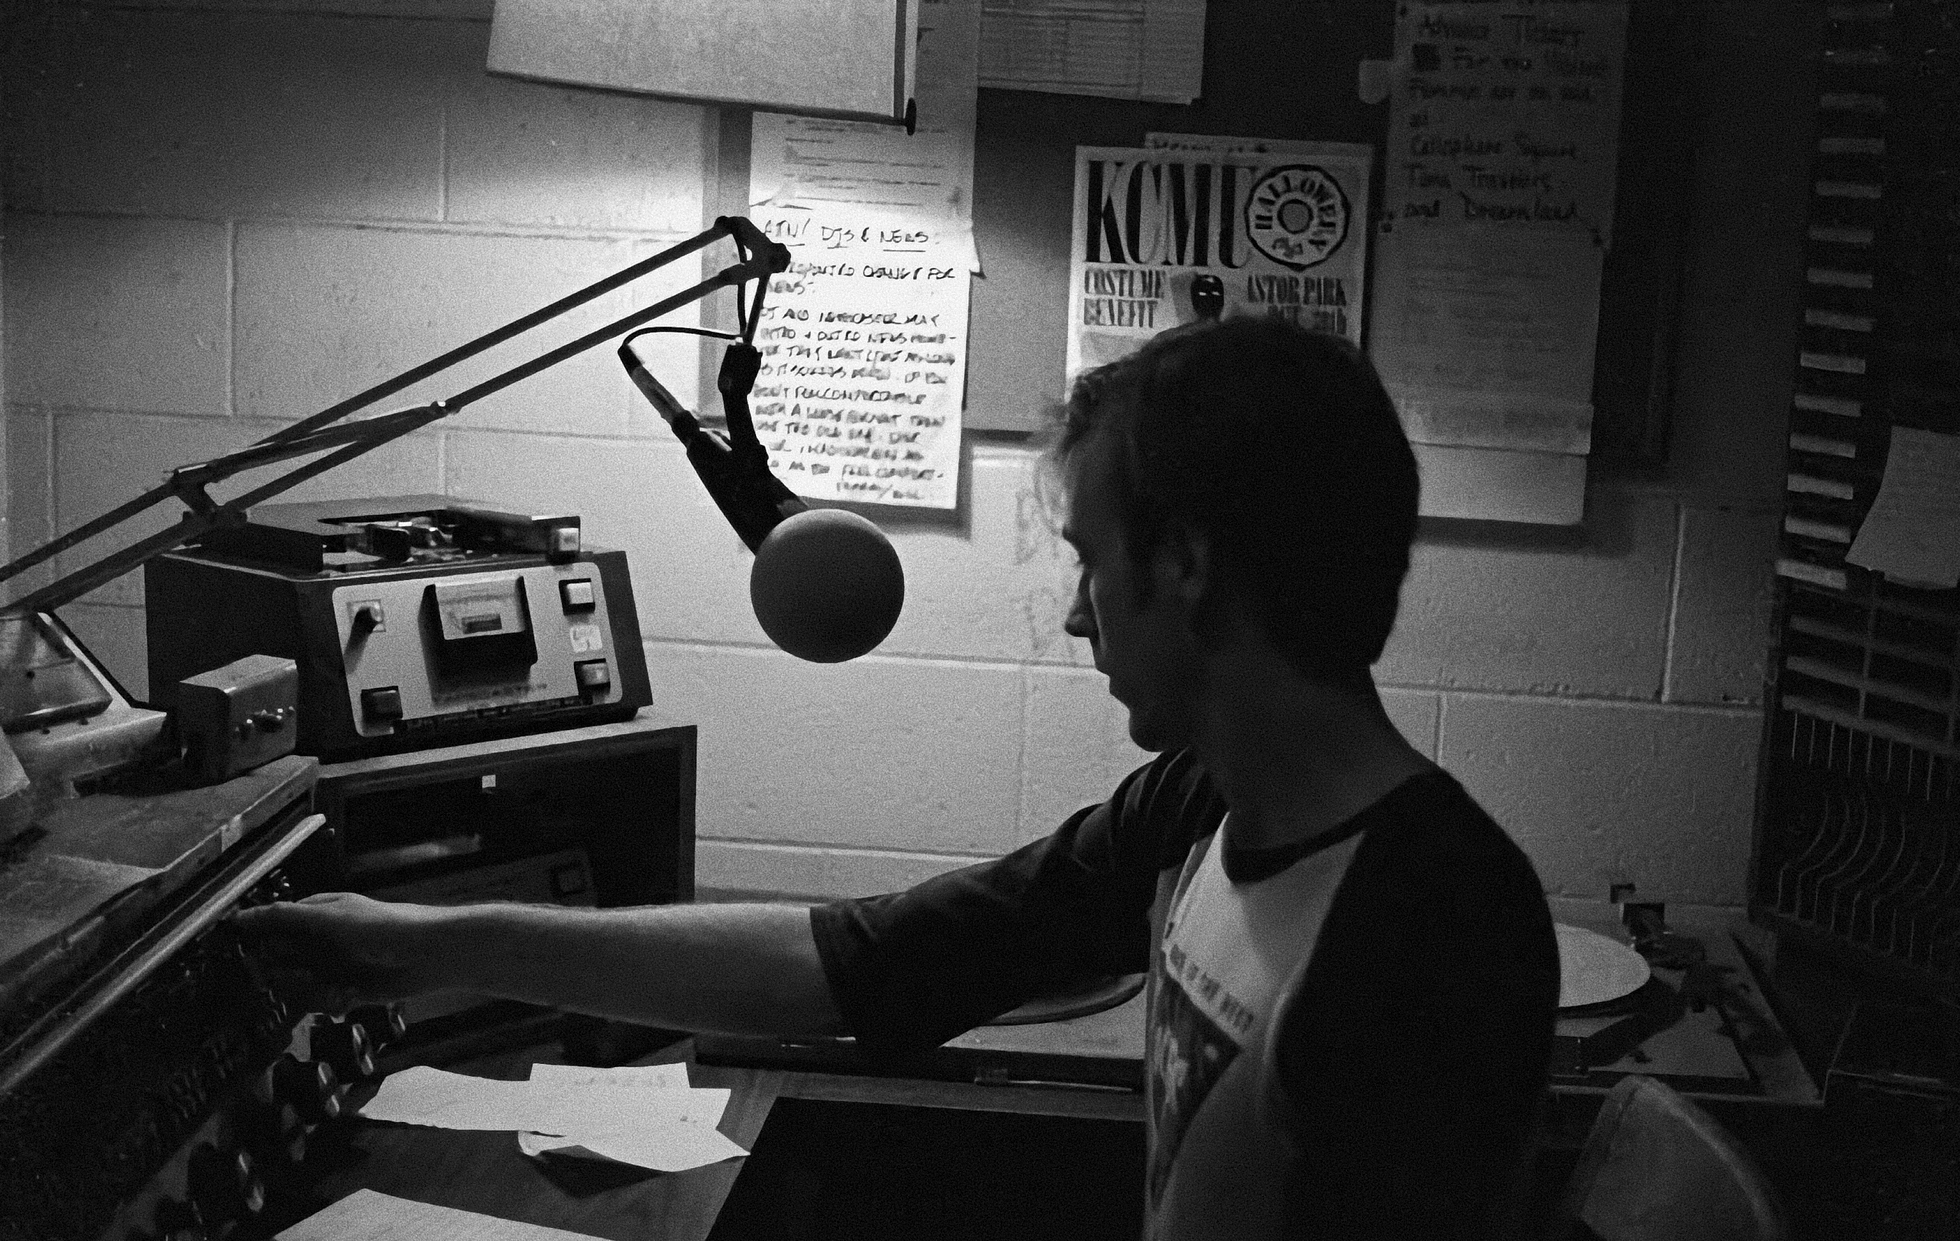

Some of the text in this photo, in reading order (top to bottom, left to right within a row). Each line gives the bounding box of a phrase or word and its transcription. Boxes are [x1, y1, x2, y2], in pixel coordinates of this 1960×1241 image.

[1084, 160, 1255, 269] KCMU
[1085, 268, 1347, 307] COSTUME ASTOR PARK
[1083, 298, 1159, 329] BENEFIT
